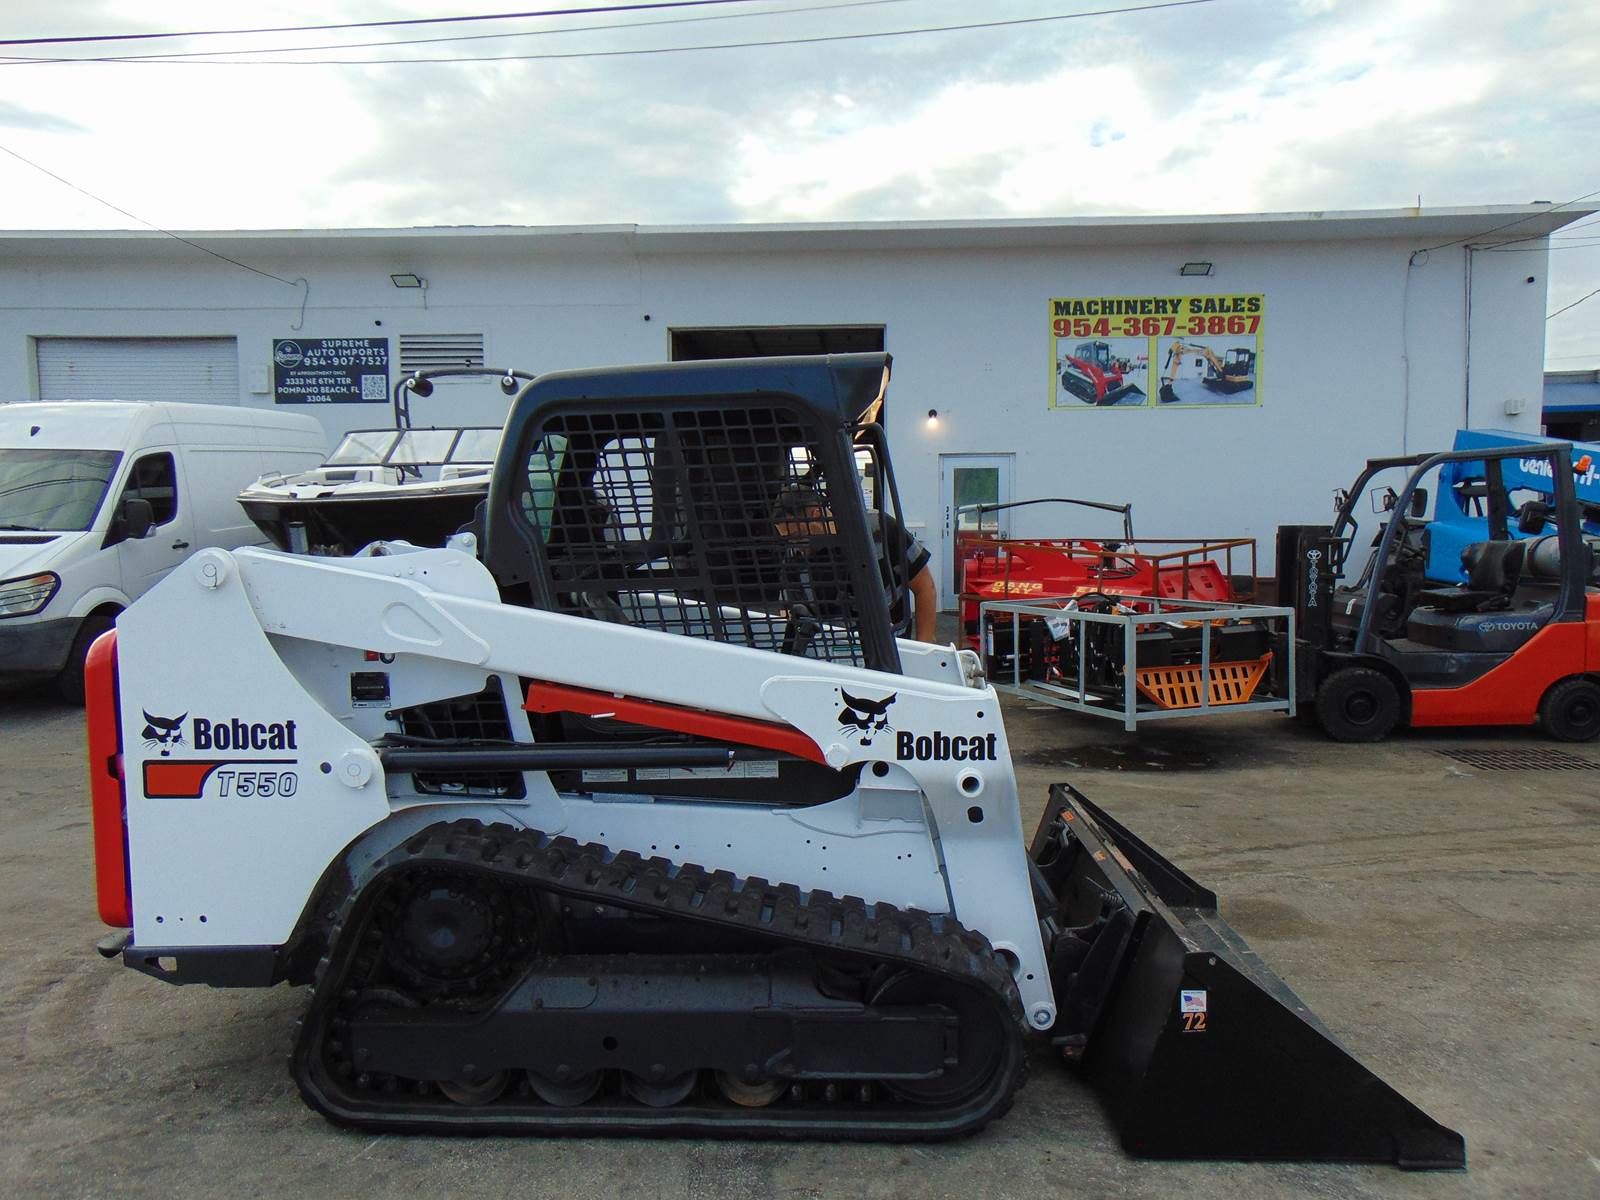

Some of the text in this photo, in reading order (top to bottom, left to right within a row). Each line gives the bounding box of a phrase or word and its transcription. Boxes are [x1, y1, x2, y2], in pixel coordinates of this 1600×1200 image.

[1054, 297, 1260, 316] MACHINERY SALES
[1053, 315, 1261, 338] 954-367-3867
[307, 348, 385, 357] AUTO IMPORTS
[321, 340, 369, 348] SUPREME
[303, 356, 387, 366] 954-907-7527
[305, 377, 317, 385] NE
[320, 386, 349, 394] BEACH,
[1308, 560, 1318, 606] TOYOTA
[1495, 622, 1538, 631] TOYOTA
[193, 718, 298, 750] Bobcat
[896, 731, 998, 761] Bobcat
[217, 771, 298, 798] T550
[1183, 1012, 1206, 1030] 72
